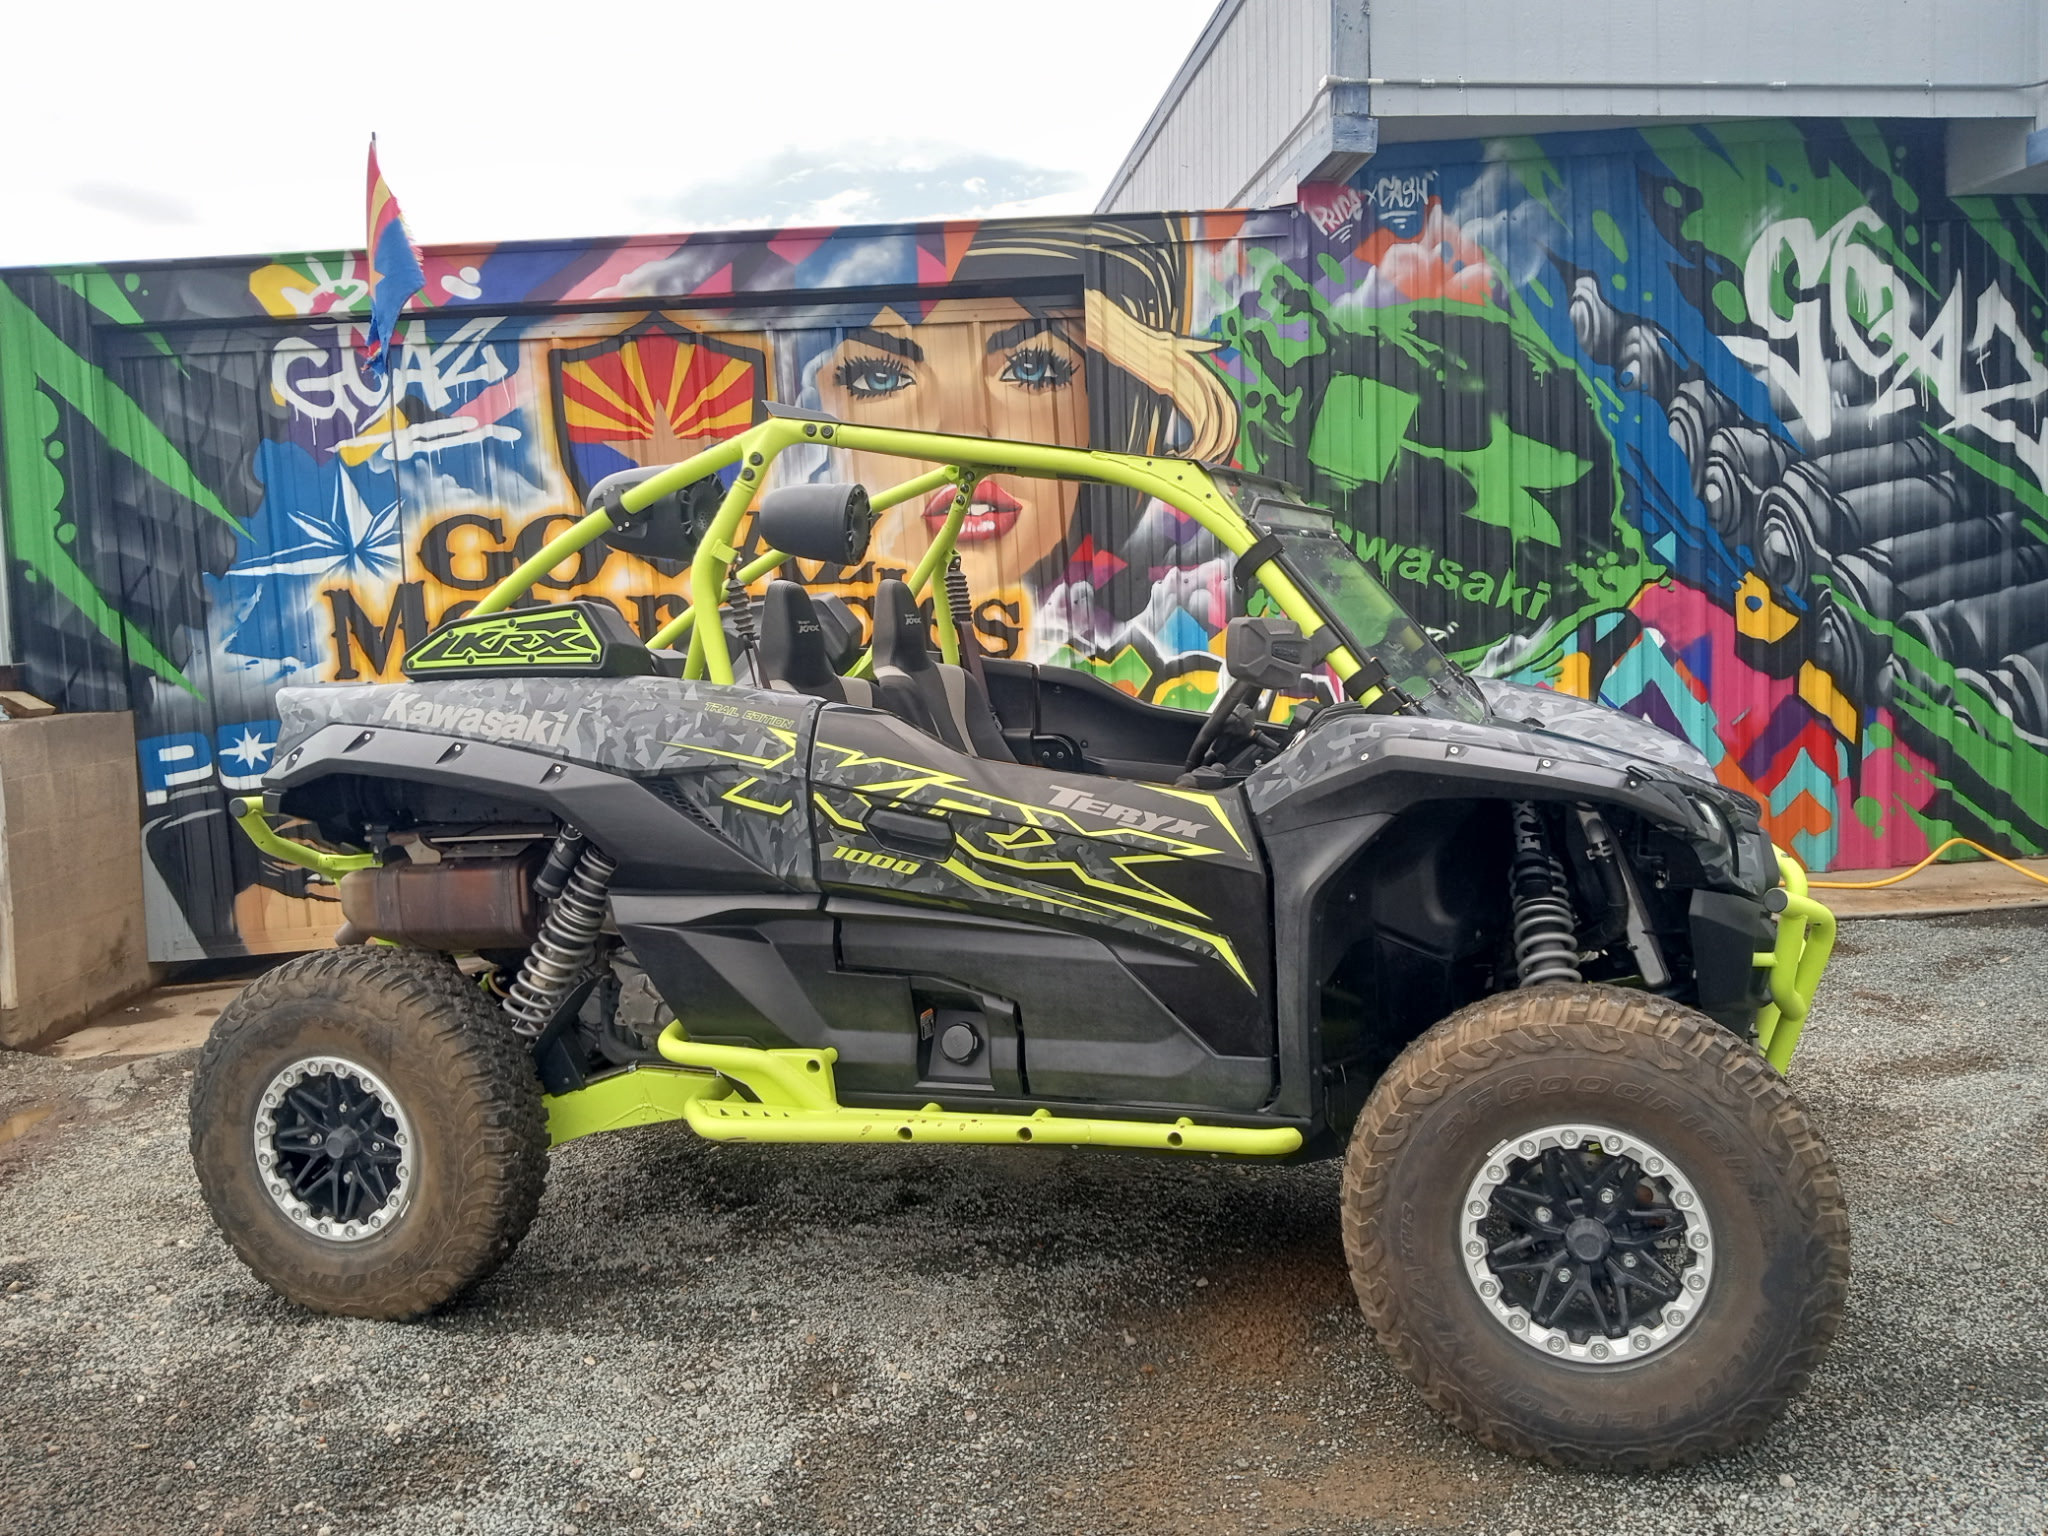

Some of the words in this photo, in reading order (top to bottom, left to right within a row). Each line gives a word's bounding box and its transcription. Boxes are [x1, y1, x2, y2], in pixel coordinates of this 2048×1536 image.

[1328, 517, 1553, 621] wasaki
[443, 627, 590, 659] KRX
[381, 692, 572, 748] Kawasaki
[704, 701, 740, 718] TRAIL
[741, 710, 795, 729] EDITION
[1048, 784, 1210, 838] TERYX
[832, 845, 921, 875] 1000
[1435, 1072, 1753, 1188] BFGoodrich
